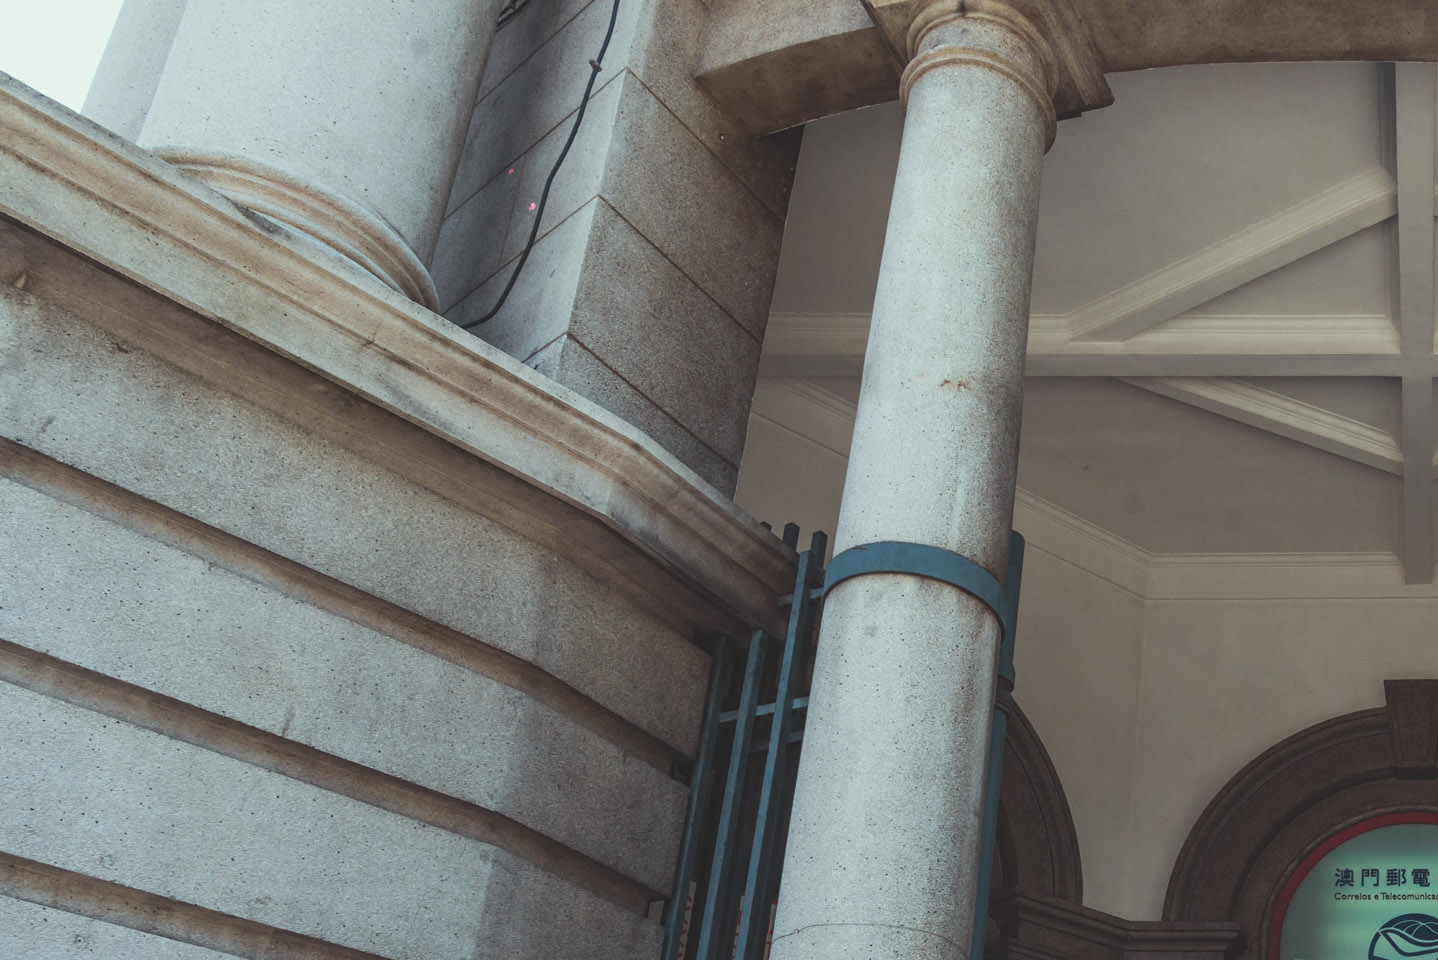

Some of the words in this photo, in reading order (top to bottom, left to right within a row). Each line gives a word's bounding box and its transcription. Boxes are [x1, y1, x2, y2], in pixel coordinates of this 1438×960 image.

[1334, 868, 1430, 887] 澳門郵電
[1334, 892, 1371, 900] Correios
